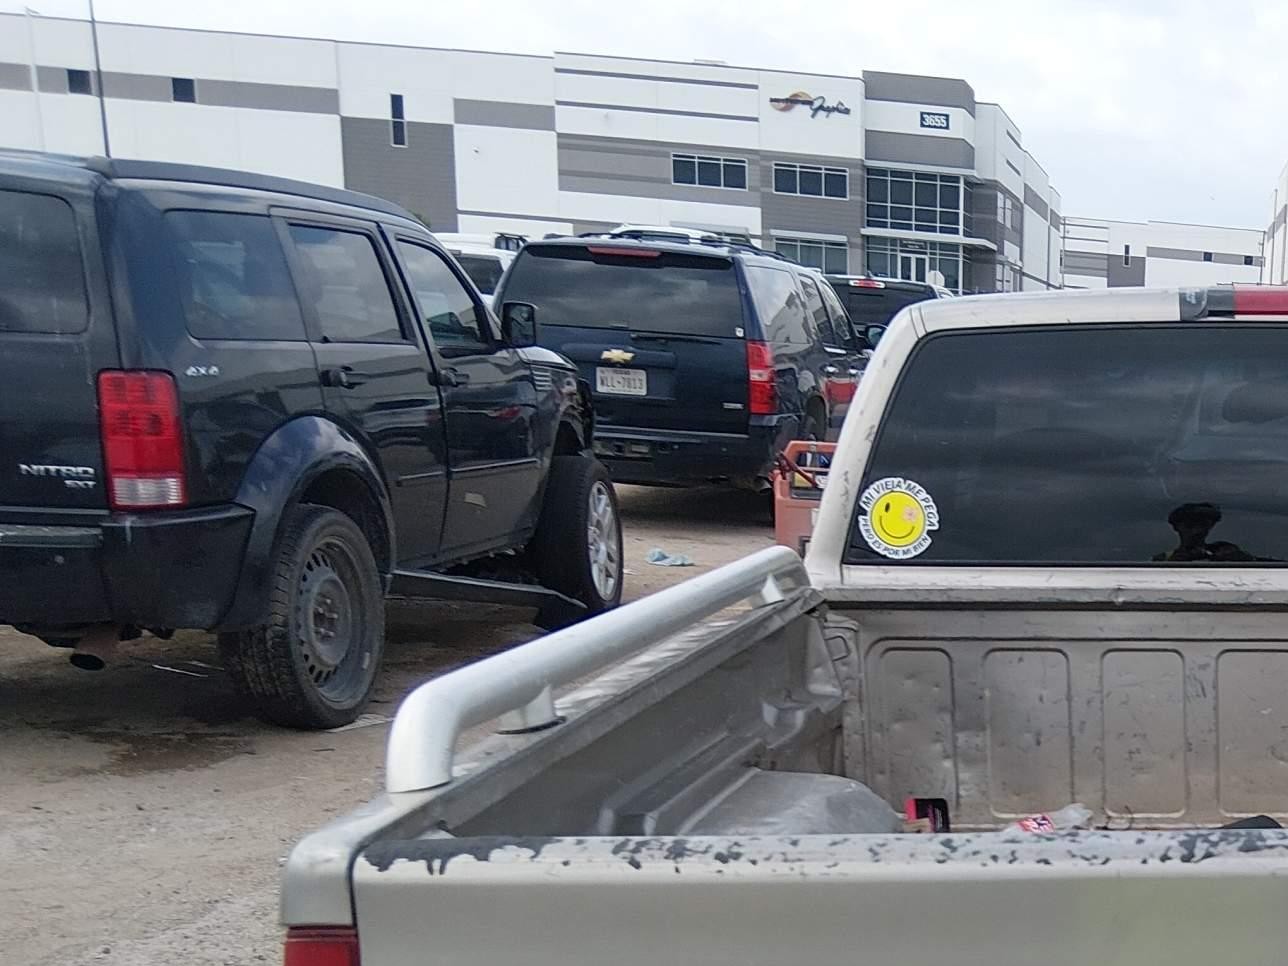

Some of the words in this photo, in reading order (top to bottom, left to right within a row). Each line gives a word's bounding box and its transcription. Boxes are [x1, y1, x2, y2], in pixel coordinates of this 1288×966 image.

[922, 113, 947, 127] 3655
[17, 463, 95, 478] NITRO
[63, 479, 97, 489] SXT
[862, 491, 876, 508] MI
[904, 482, 924, 498] ME
[921, 496, 938, 528] PEGA
